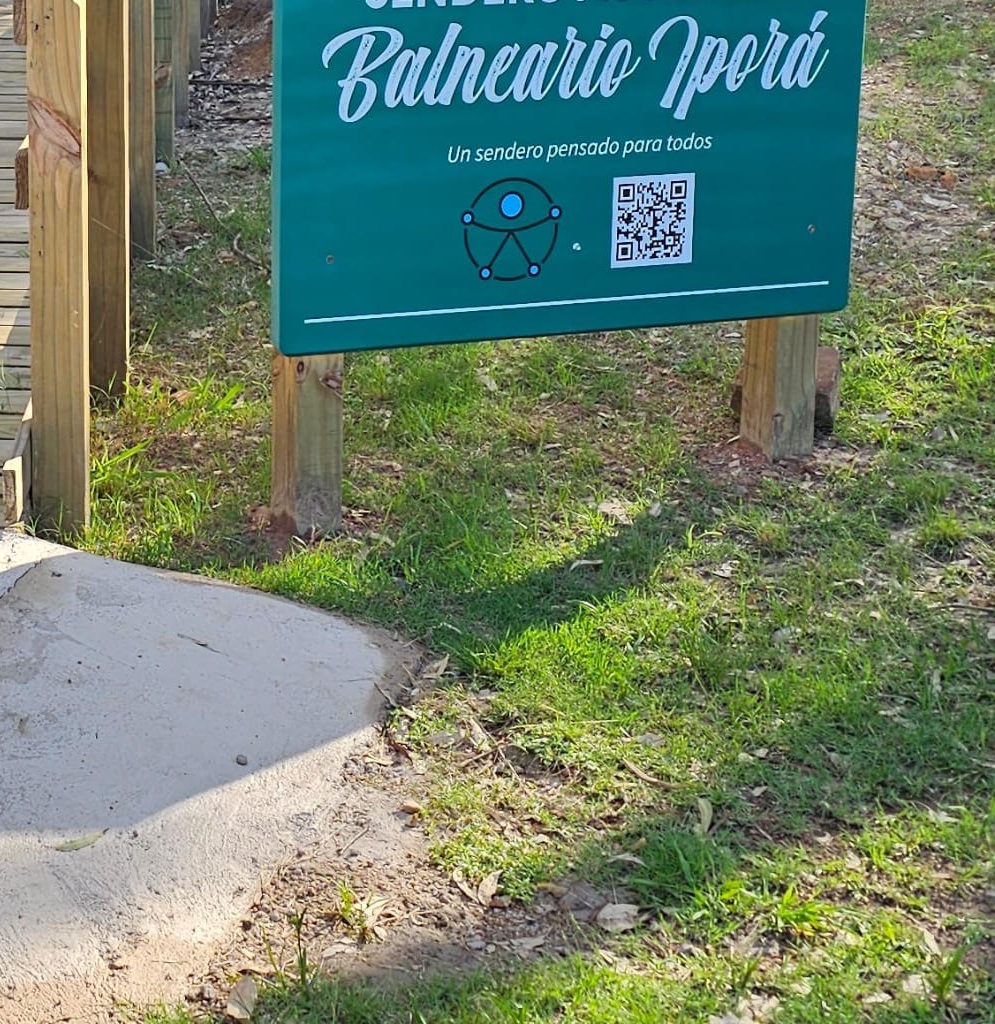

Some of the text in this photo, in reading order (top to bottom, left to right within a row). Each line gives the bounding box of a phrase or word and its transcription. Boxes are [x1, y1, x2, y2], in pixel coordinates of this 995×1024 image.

[322, 11, 829, 122] Balneario Iporá
[448, 133, 712, 163] Un sendero pensado para todos
